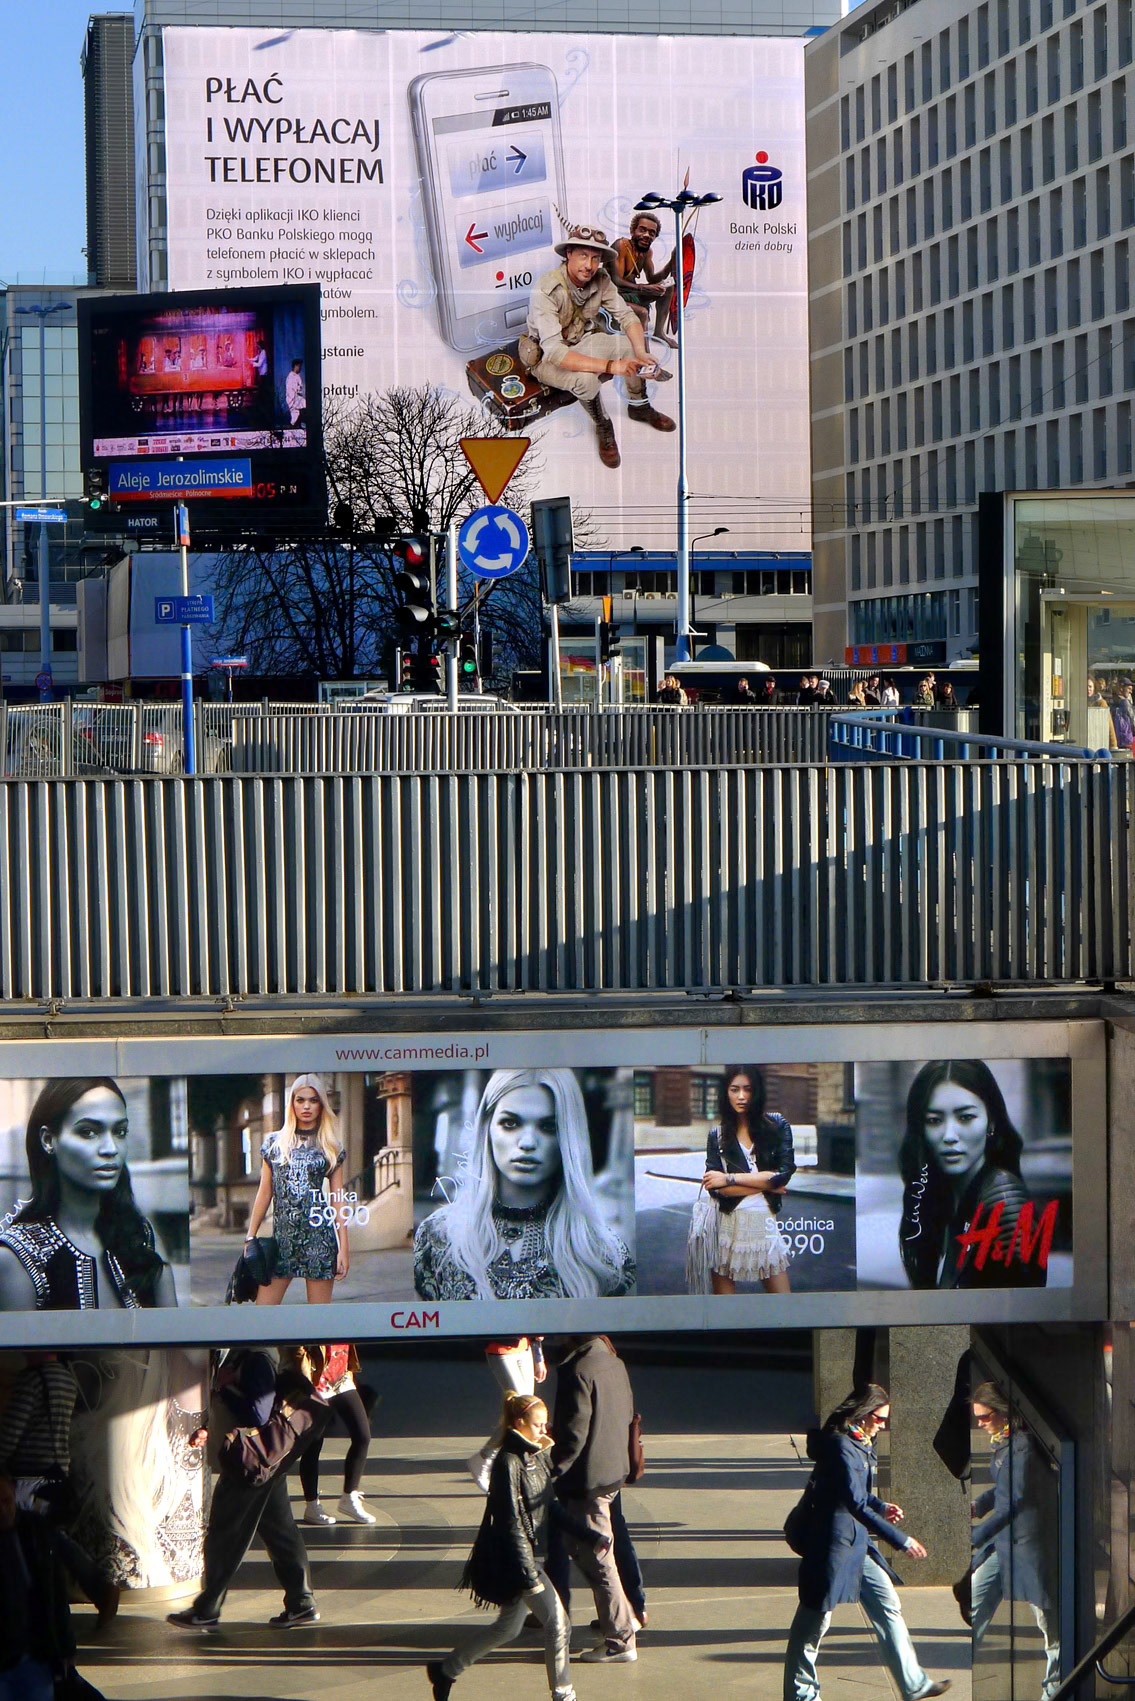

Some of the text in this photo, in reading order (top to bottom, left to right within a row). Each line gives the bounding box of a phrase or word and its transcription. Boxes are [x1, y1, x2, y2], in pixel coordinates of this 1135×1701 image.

[206, 72, 283, 104] PŁAĆ
[522, 105, 549, 118] 1:45 AM
[207, 117, 380, 152] I WYPŁACAJ
[204, 156, 384, 184] TELEFONEM
[206, 208, 361, 224] Dzięki aplikacji IKO klienci
[493, 210, 544, 243] wypłacaj
[730, 222, 797, 235] Bank Polski
[206, 228, 373, 244] PKO Banku Polskiego mogą
[734, 241, 793, 253] dzień dobry
[206, 247, 376, 264] telefonem płacić w sklepach
[206, 267, 373, 283] z symbolem IKO i wypłacać
[509, 271, 533, 290] IKO
[320, 289, 352, 299] atów
[320, 307, 378, 322] ymbolem.
[321, 346, 364, 360] ystanie
[322, 384, 359, 398] płaty!
[118, 468, 244, 492] Aleje Jerozolimskie
[128, 518, 158, 527] HATOR
[161, 604, 171, 617] P
[335, 1043, 489, 1060] www.cammedia.pl
[309, 1188, 358, 1203] Tunika
[308, 1205, 370, 1230] 59,90
[765, 1216, 834, 1231] Spódnica
[955, 1200, 1059, 1271] H&M
[765, 1233, 825, 1258] 79,90
[390, 1311, 440, 1329] CAM
